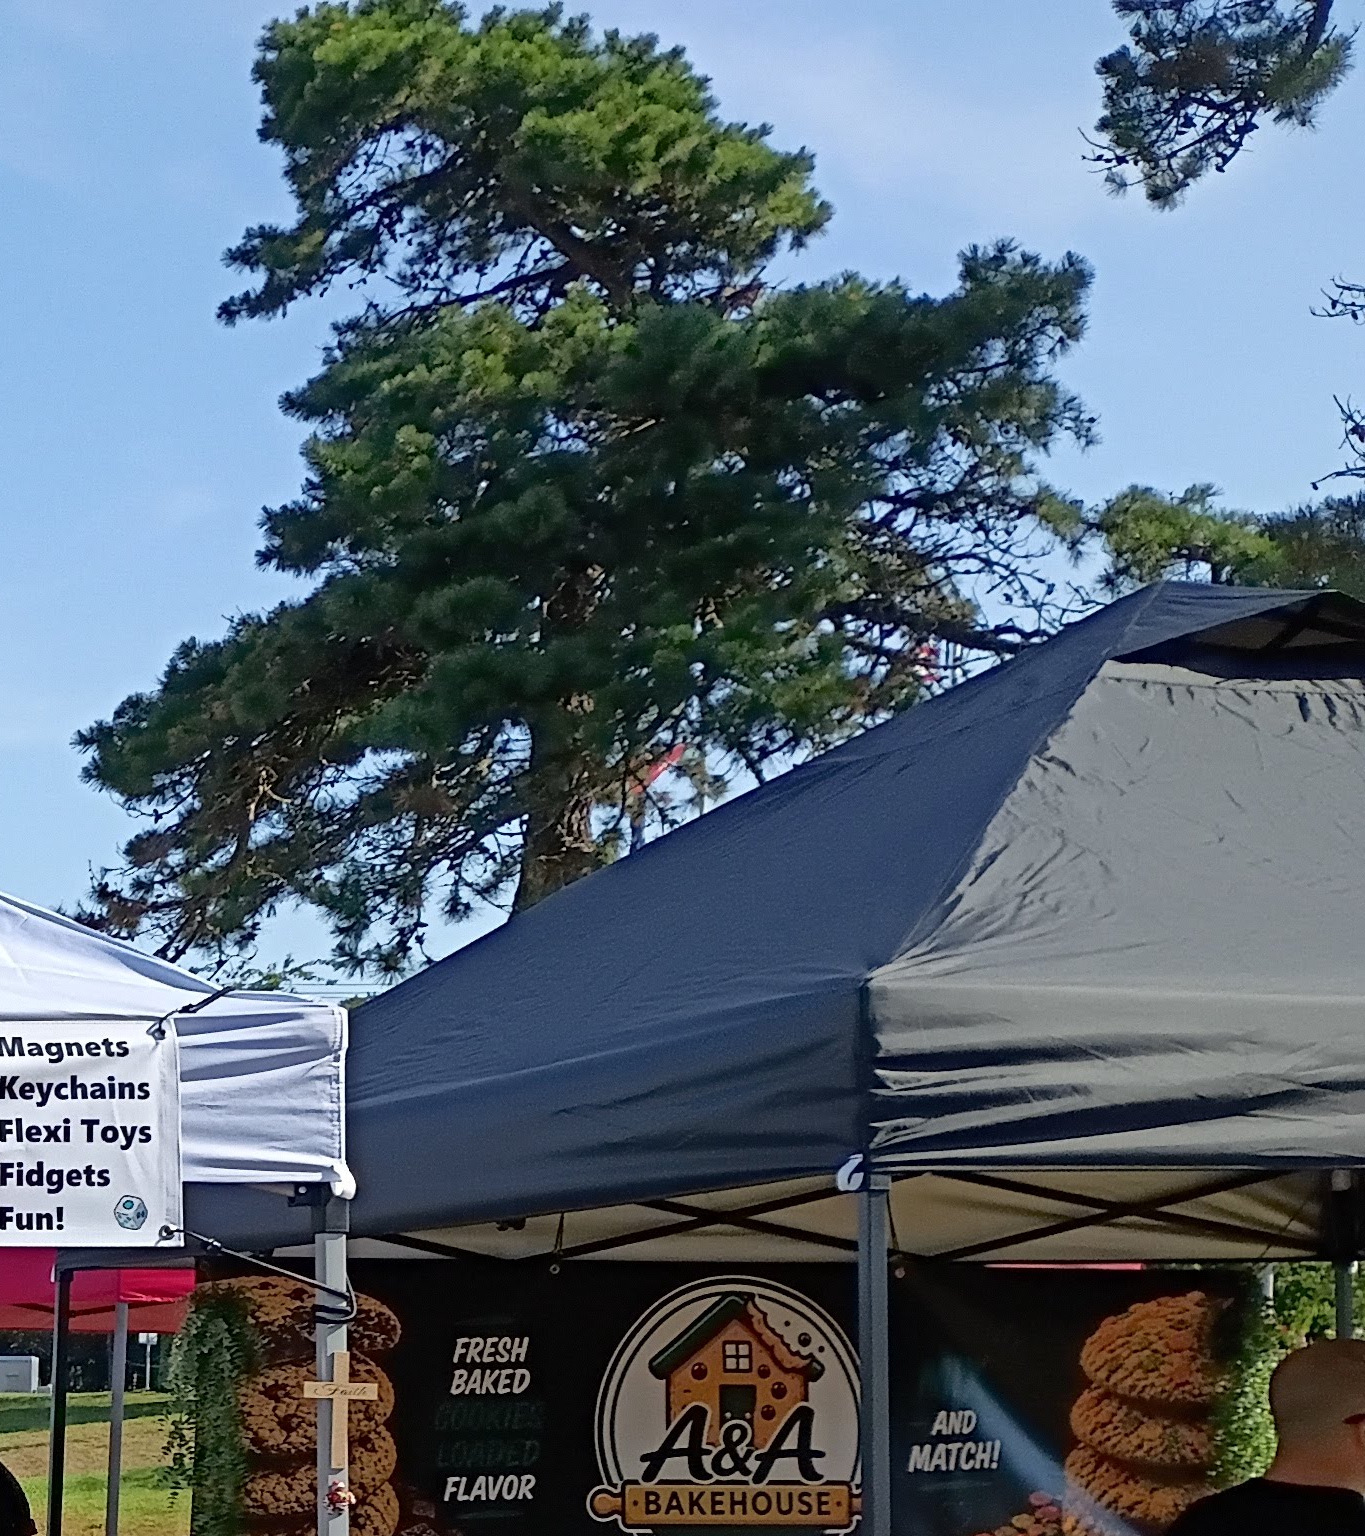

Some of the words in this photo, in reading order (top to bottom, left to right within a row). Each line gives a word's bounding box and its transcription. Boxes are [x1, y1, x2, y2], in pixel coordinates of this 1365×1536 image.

[80, 1118, 153, 1149] Toys
[0, 1162, 111, 1193] Fidgets
[0, 1206, 65, 1232] Fun!
[453, 1336, 530, 1364] FRESH
[313, 1383, 369, 1397] Faith
[450, 1369, 531, 1395] BAKED
[931, 1410, 976, 1435] AND
[640, 1404, 826, 1484] A&A
[908, 1439, 1002, 1474] MATCH!
[444, 1475, 537, 1502] FLAVOR
[644, 1490, 831, 1517] BAKEHOUSE
